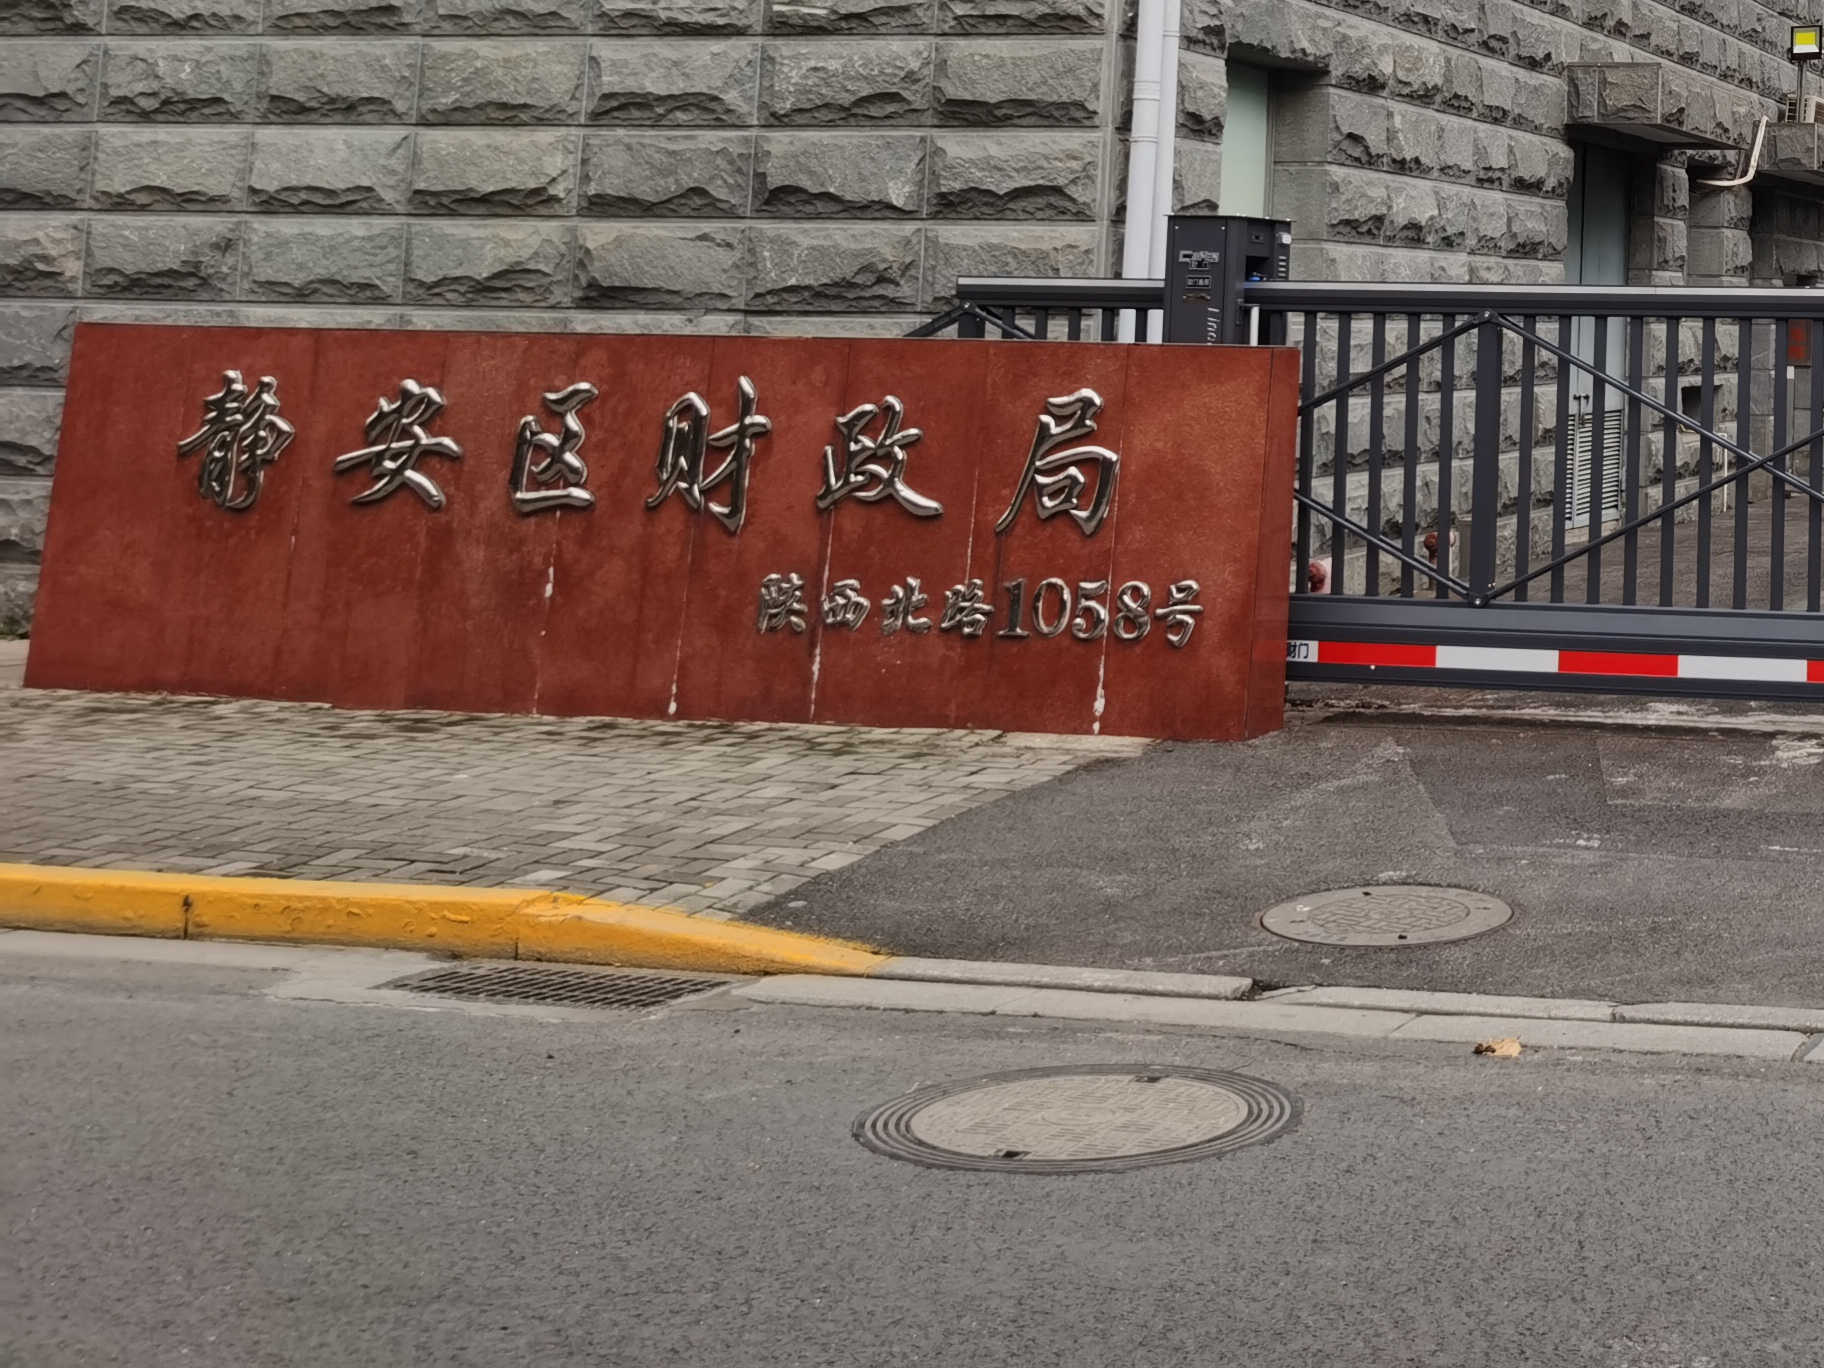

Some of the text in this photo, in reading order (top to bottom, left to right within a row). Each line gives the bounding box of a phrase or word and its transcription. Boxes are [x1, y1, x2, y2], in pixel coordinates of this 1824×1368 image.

[176, 369, 1120, 535] 静安区财政局
[757, 572, 1204, 648] 陕西北路1058号
